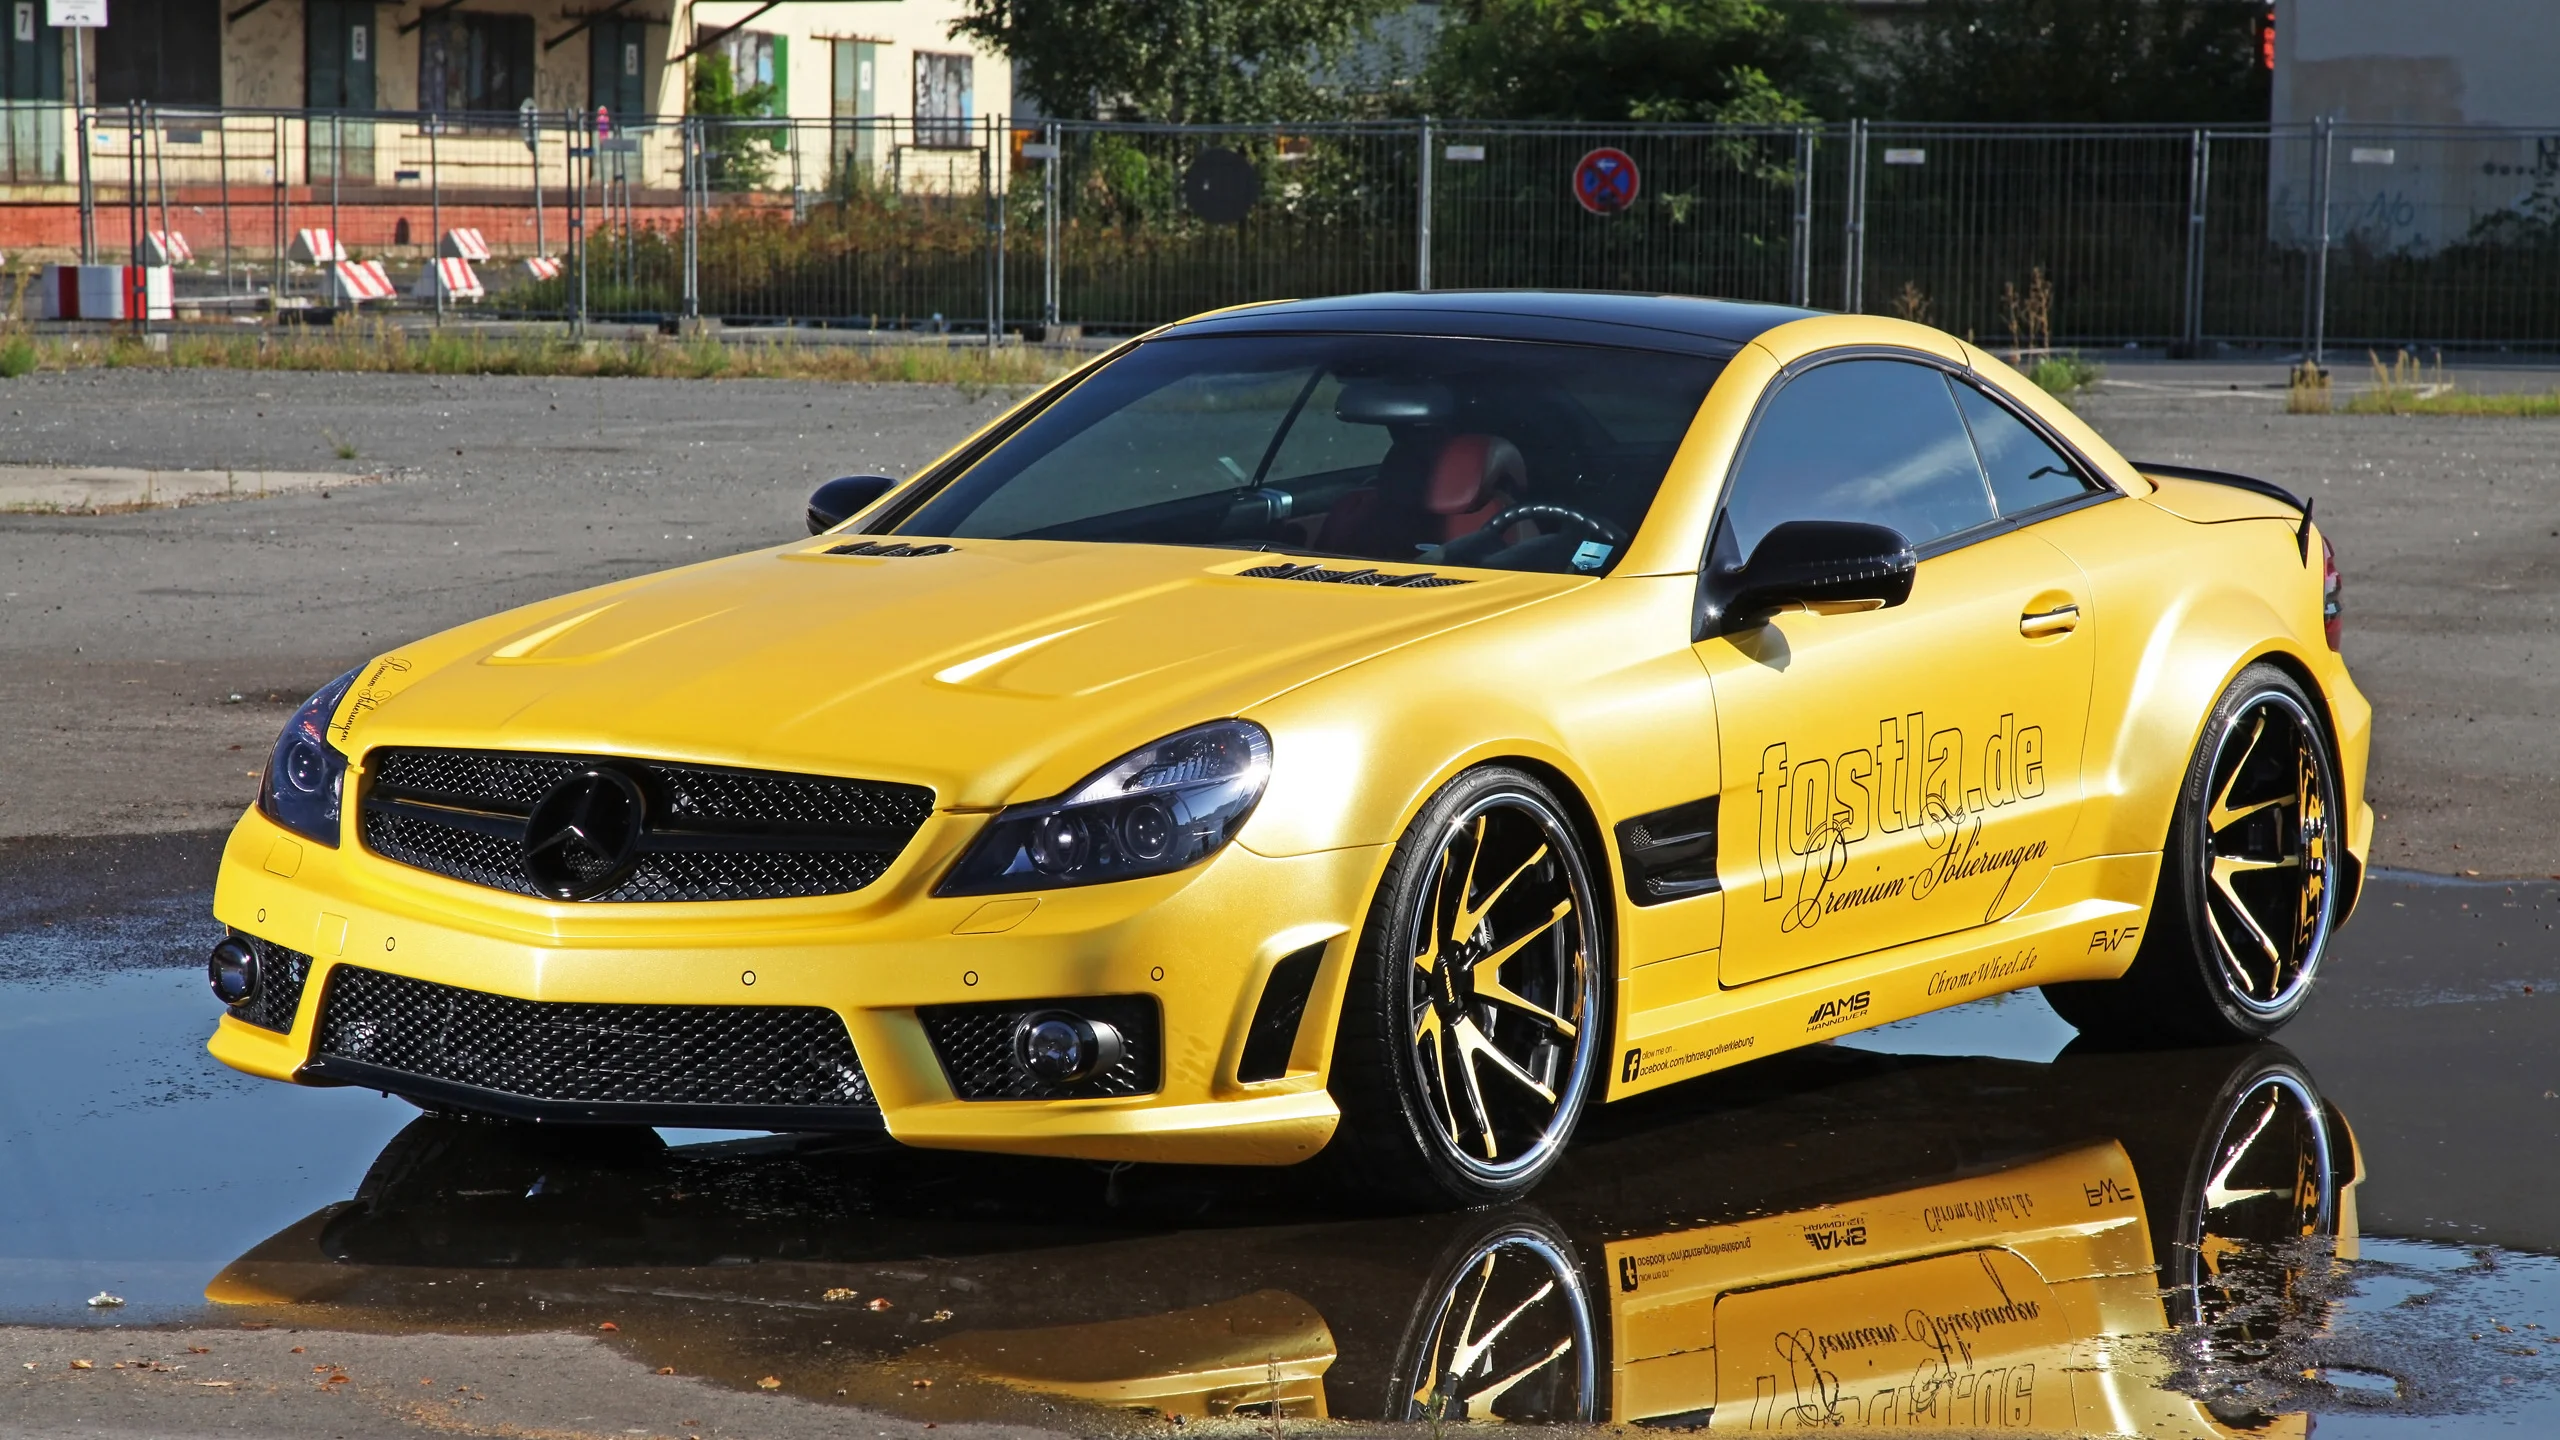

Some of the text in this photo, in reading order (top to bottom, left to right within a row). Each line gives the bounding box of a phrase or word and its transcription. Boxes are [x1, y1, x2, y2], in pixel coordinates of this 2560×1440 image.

[20, 9, 29, 33] 7
[1757, 711, 2045, 902] fostla.de
[1927, 947, 2038, 996] ChromeWheel.de
[1818, 990, 1871, 1021] AMS
[1806, 1009, 1868, 1033] HANNOVER
[1655, 1046, 1665, 1056] me
